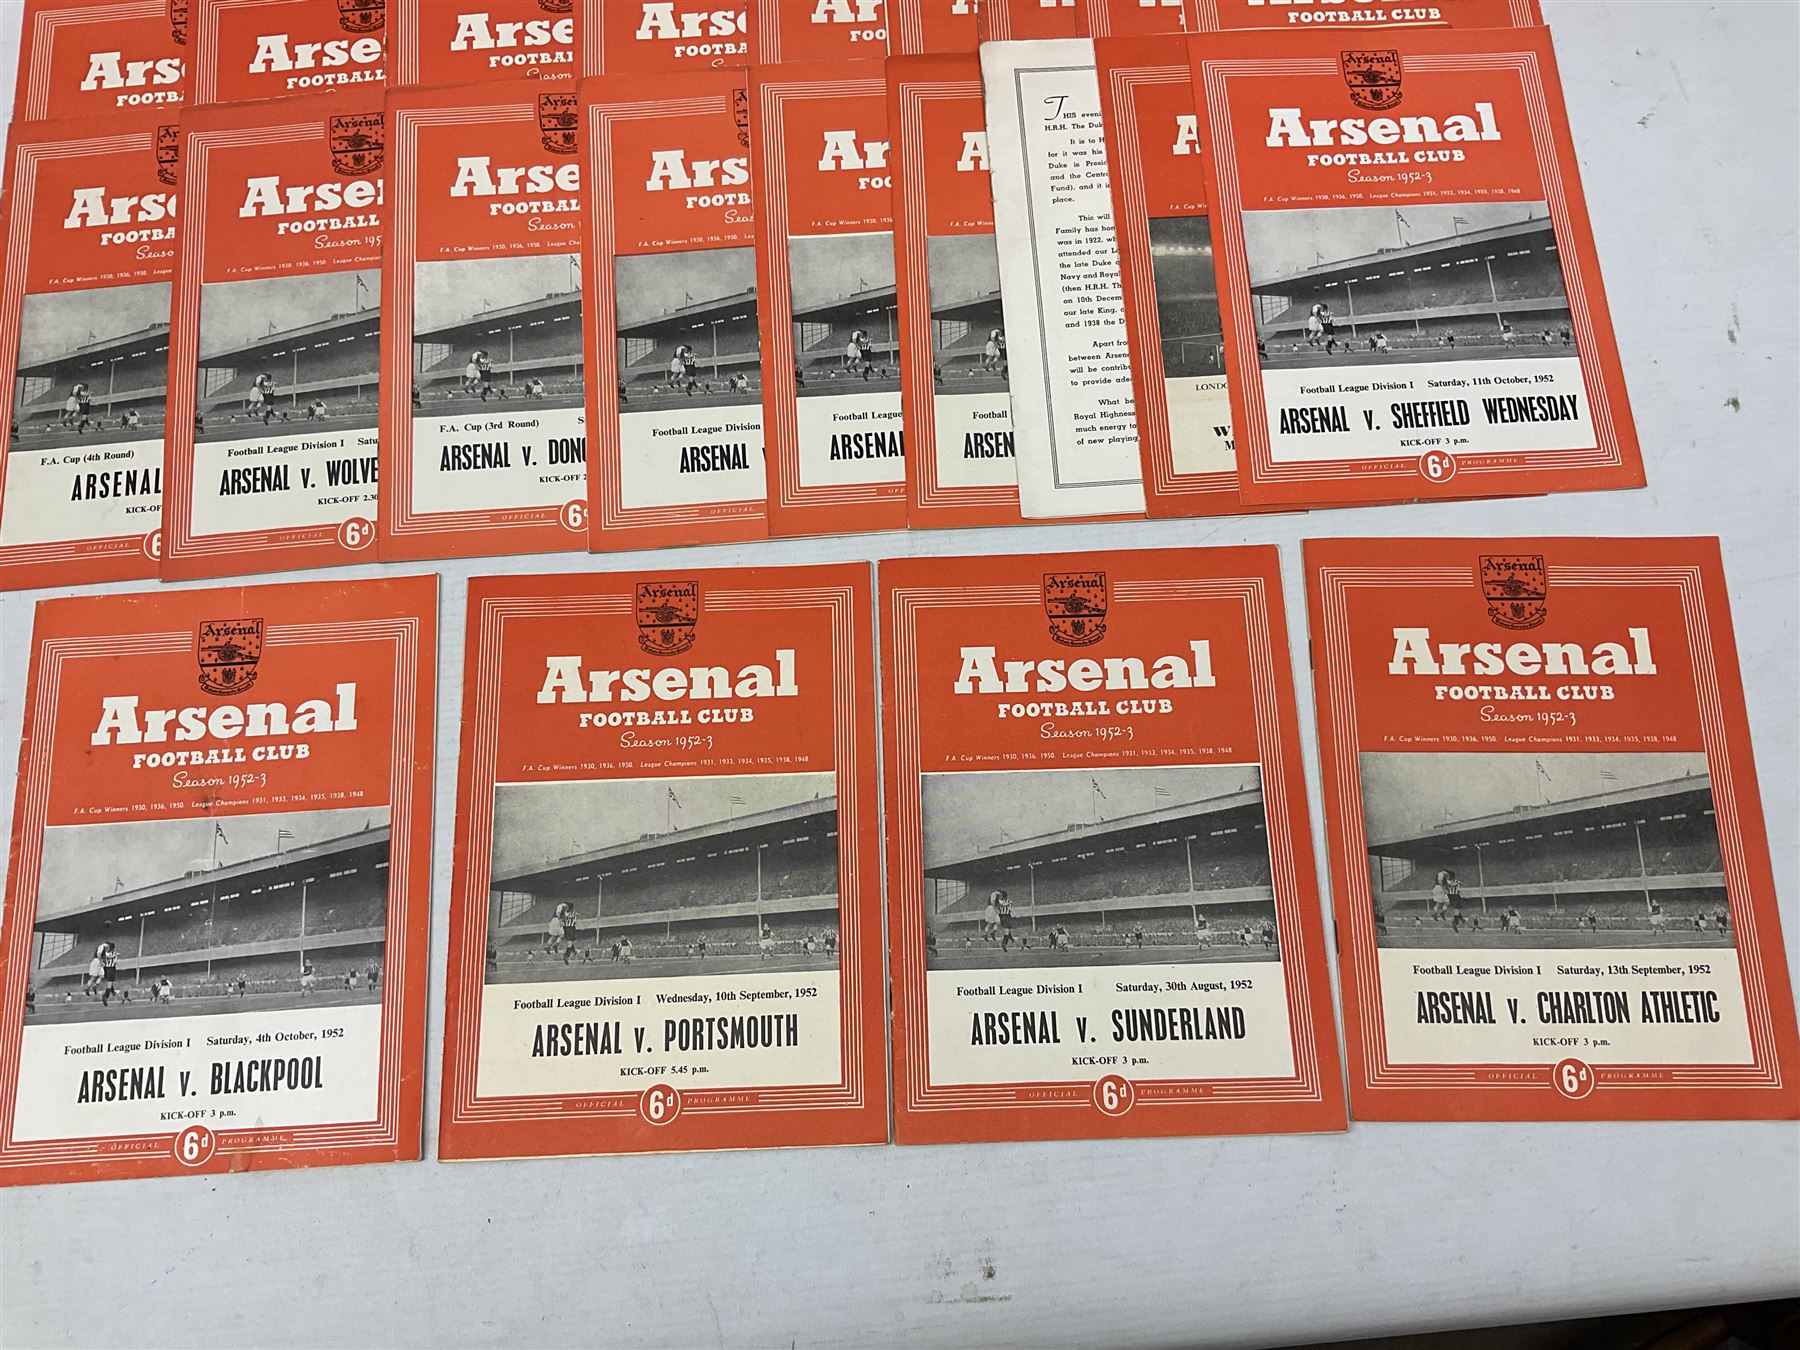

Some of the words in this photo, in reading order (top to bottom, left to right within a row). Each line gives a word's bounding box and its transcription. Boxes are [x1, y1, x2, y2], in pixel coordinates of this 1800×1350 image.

[1288, 9, 1387, 23] FOOTBALL
[1392, 8, 1441, 21] CLUB
[1266, 102, 1501, 148] Arsenal
[1308, 152, 1409, 166] FOOTBALL
[1414, 149, 1466, 162] CLUB
[1348, 169, 1395, 184] Season
[1398, 171, 1432, 183] 1952-3
[278, 215, 379, 234] FOOTBALL
[1300, 384, 1335, 395] Football
[1338, 383, 1369, 394] League
[1372, 381, 1406, 391] Division
[1409, 382, 1414, 390] I
[1428, 377, 1469, 389] Saturday,
[1472, 377, 1491, 387] 11th
[1494, 375, 1531, 386] October,
[1535, 374, 1554, 383] 1952
[1098, 398, 1120, 406] What
[833, 412, 868, 422] Football
[1074, 412, 1096, 420] Royal
[1280, 406, 1350, 435] ARSENAL
[1391, 399, 1470, 429] SHEFFIELD
[1482, 394, 1579, 425] WEDNESDAY
[1076, 425, 1097, 433] much
[1100, 423, 1126, 431] energy
[228, 446, 264, 457] Football
[267, 443, 298, 454] League
[302, 441, 337, 451] Division
[340, 440, 344, 448] I
[1108, 435, 1138, 444] playing
[1400, 437, 1441, 447] KICK-OFF
[1445, 437, 1450, 445] 3
[1453, 438, 1469, 446] p.m.
[41, 456, 59, 466] F.A.
[63, 455, 80, 465] Cup
[83, 453, 100, 463] (4th
[104, 450, 134, 461] Round)
[440, 442, 511, 472] ARSENAL
[680, 443, 749, 474] ARSENAL
[1427, 454, 1449, 478] 6d
[71, 468, 161, 502] ARSENAL
[219, 464, 290, 496] ARSENAL
[346, 522, 369, 545] 6d
[1484, 558, 1542, 571] Arsenal
[639, 586, 696, 598] Arsenal
[1047, 576, 1104, 589] Arsenal
[203, 624, 261, 637] Arsenal
[1388, 628, 1657, 675] Arsenal
[537, 649, 798, 704] Arsenal
[954, 640, 1216, 695] Arsenal
[1435, 686, 1551, 700] FOOTBALL
[1557, 686, 1614, 699] CLUB
[91, 683, 357, 745] Arsenal
[579, 710, 692, 728] FOOTBALL
[697, 708, 754, 723] CLUB
[998, 702, 1110, 718] FOOTBALL
[1116, 699, 1173, 714] CLUB
[1480, 706, 1533, 722] Season
[1537, 713, 1576, 726] 1952-3
[620, 732, 672, 748] Season
[676, 735, 713, 750] 1952-3
[1040, 723, 1092, 739] Season
[1096, 727, 1133, 741] 1952-3
[1399, 735, 1412, 743] Cup
[1504, 735, 1526, 743] League
[1528, 735, 1563, 743] Champions
[133, 749, 247, 768] FOOTBALL
[252, 744, 310, 760] CLUB
[173, 772, 224, 789] Season
[229, 772, 266, 789] 1952-3
[1413, 965, 1453, 975] Football
[1456, 965, 1491, 977] League
[1494, 965, 1533, 975] Division
[1536, 966, 1541, 974] I
[1557, 965, 1604, 977] Saturday,
[1608, 965, 1628, 975] 13th
[1631, 965, 1685, 977] September,
[1688, 965, 1711, 974] 1952
[957, 985, 995, 995] Football
[999, 985, 1033, 996] League
[1036, 984, 1075, 994] Division
[1078, 985, 1083, 993] I
[1115, 981, 1162, 993] Saturday,
[1166, 981, 1186, 991] 30th
[1191, 981, 1226, 993] August,
[1230, 980, 1253, 990] 1952
[514, 999, 553, 1010] Football
[557, 998, 591, 1009] League
[595, 995, 633, 1006] Division
[637, 996, 641, 1005] I
[656, 991, 712, 1005] Wednesday,
[716, 990, 736, 1000] 10th
[740, 989, 792, 1001] September,
[795, 988, 817, 998] 1952
[1417, 992, 1496, 1024] ARSENAL
[1538, 991, 1630, 1023] CHARLTON
[1641, 991, 1720, 1023] ATHLETIC
[532, 1021, 622, 1058] ARSENAL
[665, 1014, 798, 1052] PORTSMOUTH
[971, 1011, 1060, 1046] ARSENAL
[1112, 1007, 1246, 1043] SUNDERLAND
[64, 1044, 103, 1055] Football
[108, 1041, 141, 1053] League
[145, 1039, 183, 1050] Division
[186, 1038, 191, 1048] I
[206, 1034, 252, 1048] Saturday,
[256, 1032, 271, 1043] 4th
[275, 1030, 317, 1042] October,
[322, 1028, 344, 1039] 1952
[1533, 1038, 1578, 1046] KICK-OFF
[1583, 1038, 1589, 1046] 3
[1593, 1039, 1610, 1048] p.m.
[1071, 1056, 1118, 1066] KICK-OFF
[1122, 1056, 1127, 1064] 3
[1132, 1057, 1149, 1066] p.m.
[77, 1066, 165, 1104] ARSENAL
[210, 1056, 323, 1095] BLACKPOOL
[620, 1066, 666, 1077] KICK-OFF
[671, 1066, 687, 1074] 5.45
[692, 1066, 709, 1075] p.m.
[1563, 1064, 1586, 1093] 6d
[649, 1091, 673, 1119] 6d
[1103, 1081, 1126, 1110] 6d
[160, 1110, 206, 1121] KICK-OFF
[219, 1109, 236, 1119] p.m.
[182, 1131, 209, 1160] 6d
